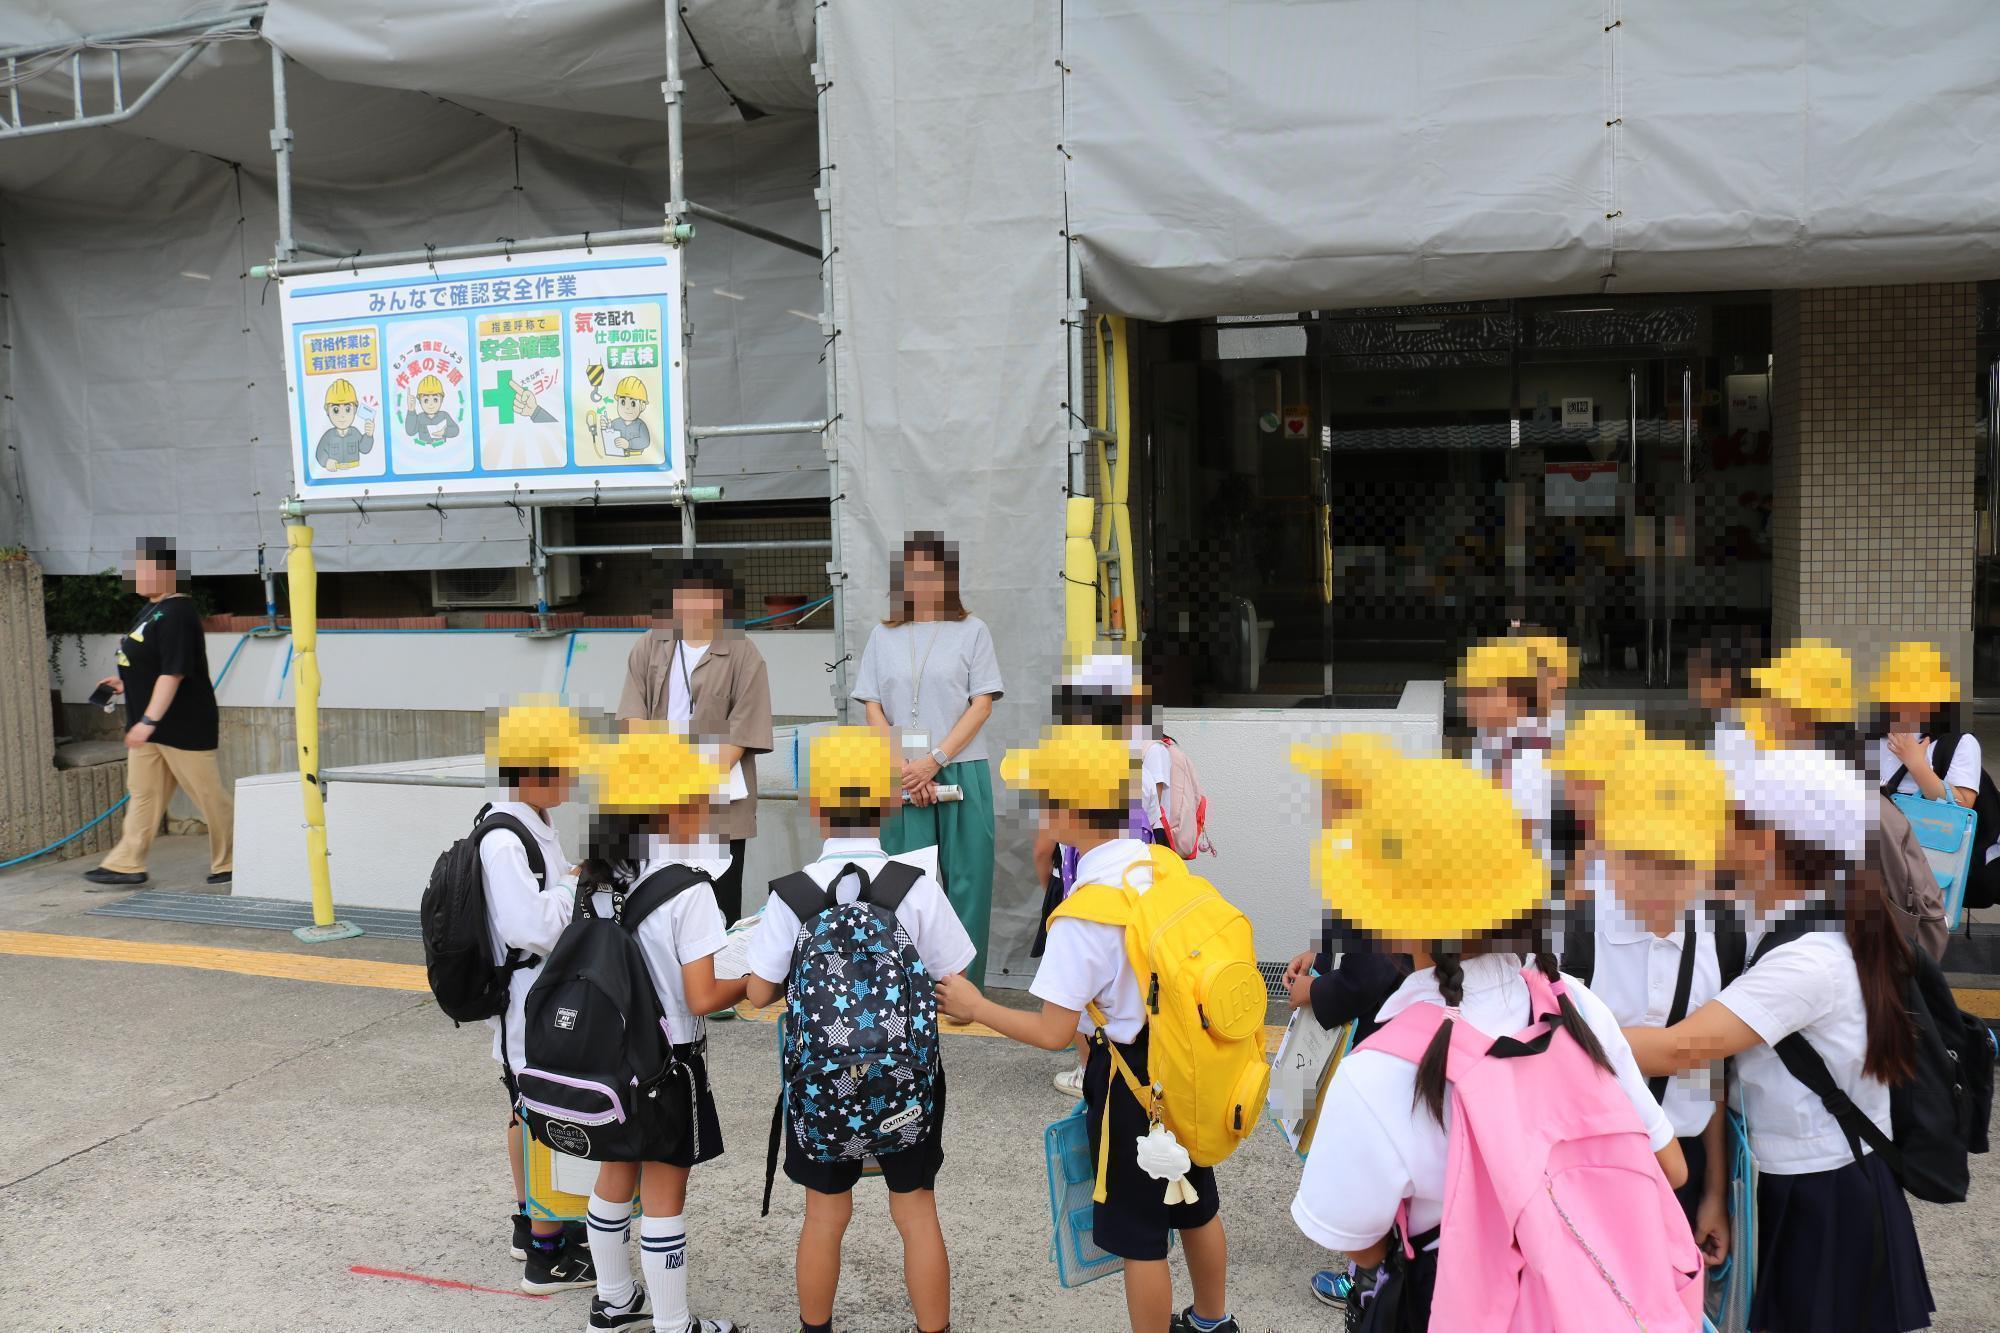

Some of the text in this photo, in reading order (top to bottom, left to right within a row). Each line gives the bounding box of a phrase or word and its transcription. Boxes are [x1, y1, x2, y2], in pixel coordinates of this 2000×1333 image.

[368, 274, 577, 313] みんなで確認安全作業
[492, 319, 546, 333] 指差呼称で
[575, 310, 635, 333] 気を配れ
[310, 334, 371, 353] 資格作業は
[480, 335, 561, 362] 安全確認
[594, 328, 657, 344] 仕事の前に
[312, 353, 371, 371] 有資格者で
[392, 340, 463, 369] もう一度確認しよう
[396, 357, 463, 389] 作業の手順
[1218, 972, 1261, 1029] LEGO
